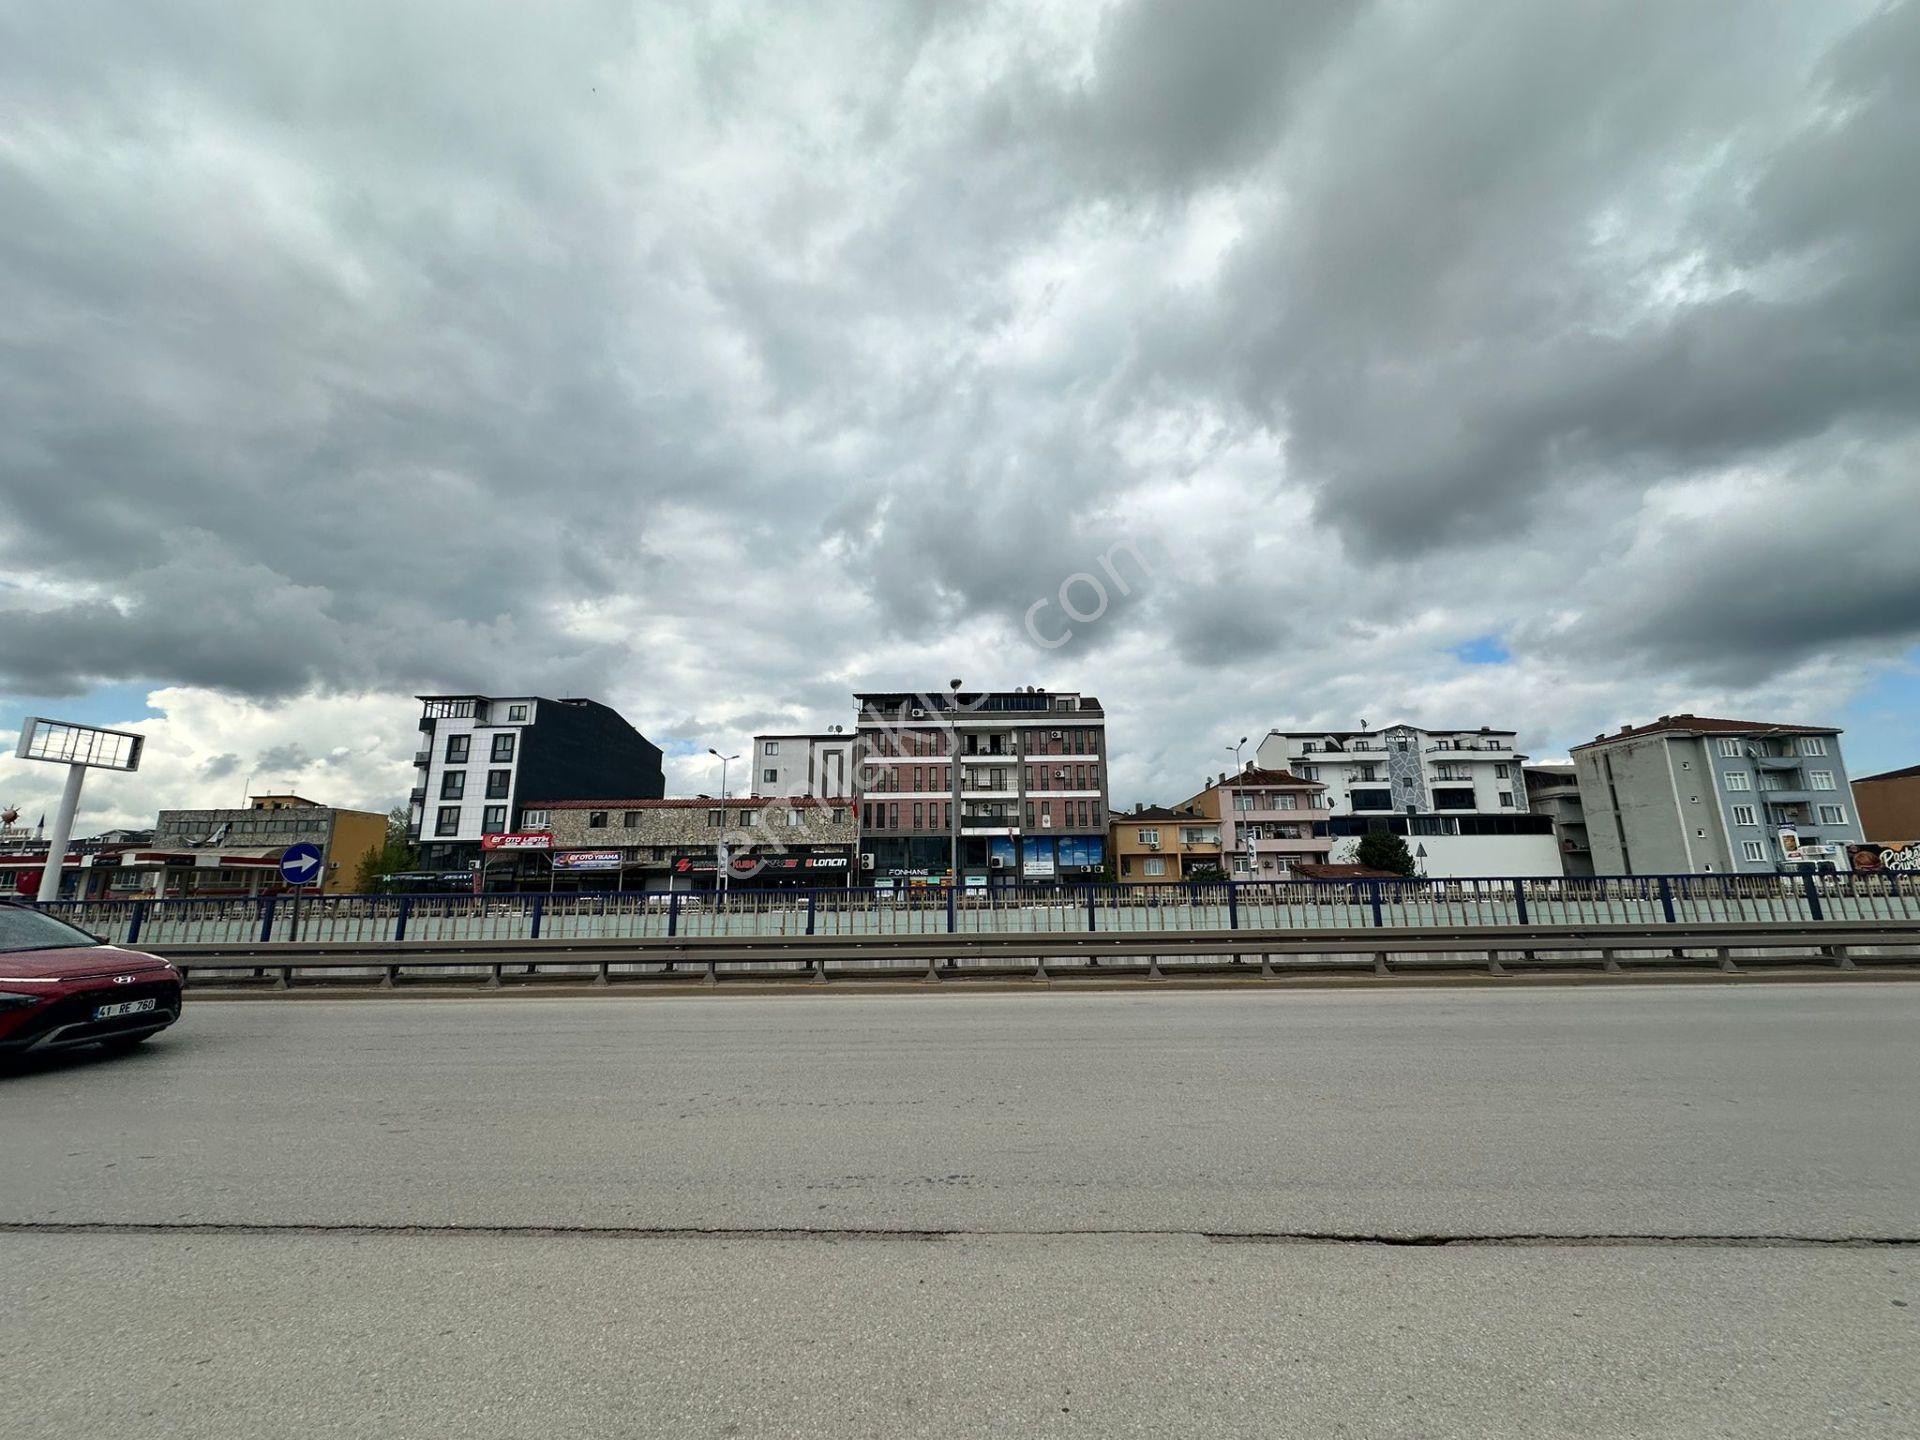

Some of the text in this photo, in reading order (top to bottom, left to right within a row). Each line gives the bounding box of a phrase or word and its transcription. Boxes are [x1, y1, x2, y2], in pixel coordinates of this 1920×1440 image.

[888, 868, 929, 876] FONHANE
[120, 1004, 130, 1014] RE
[137, 1000, 154, 1011] 760
